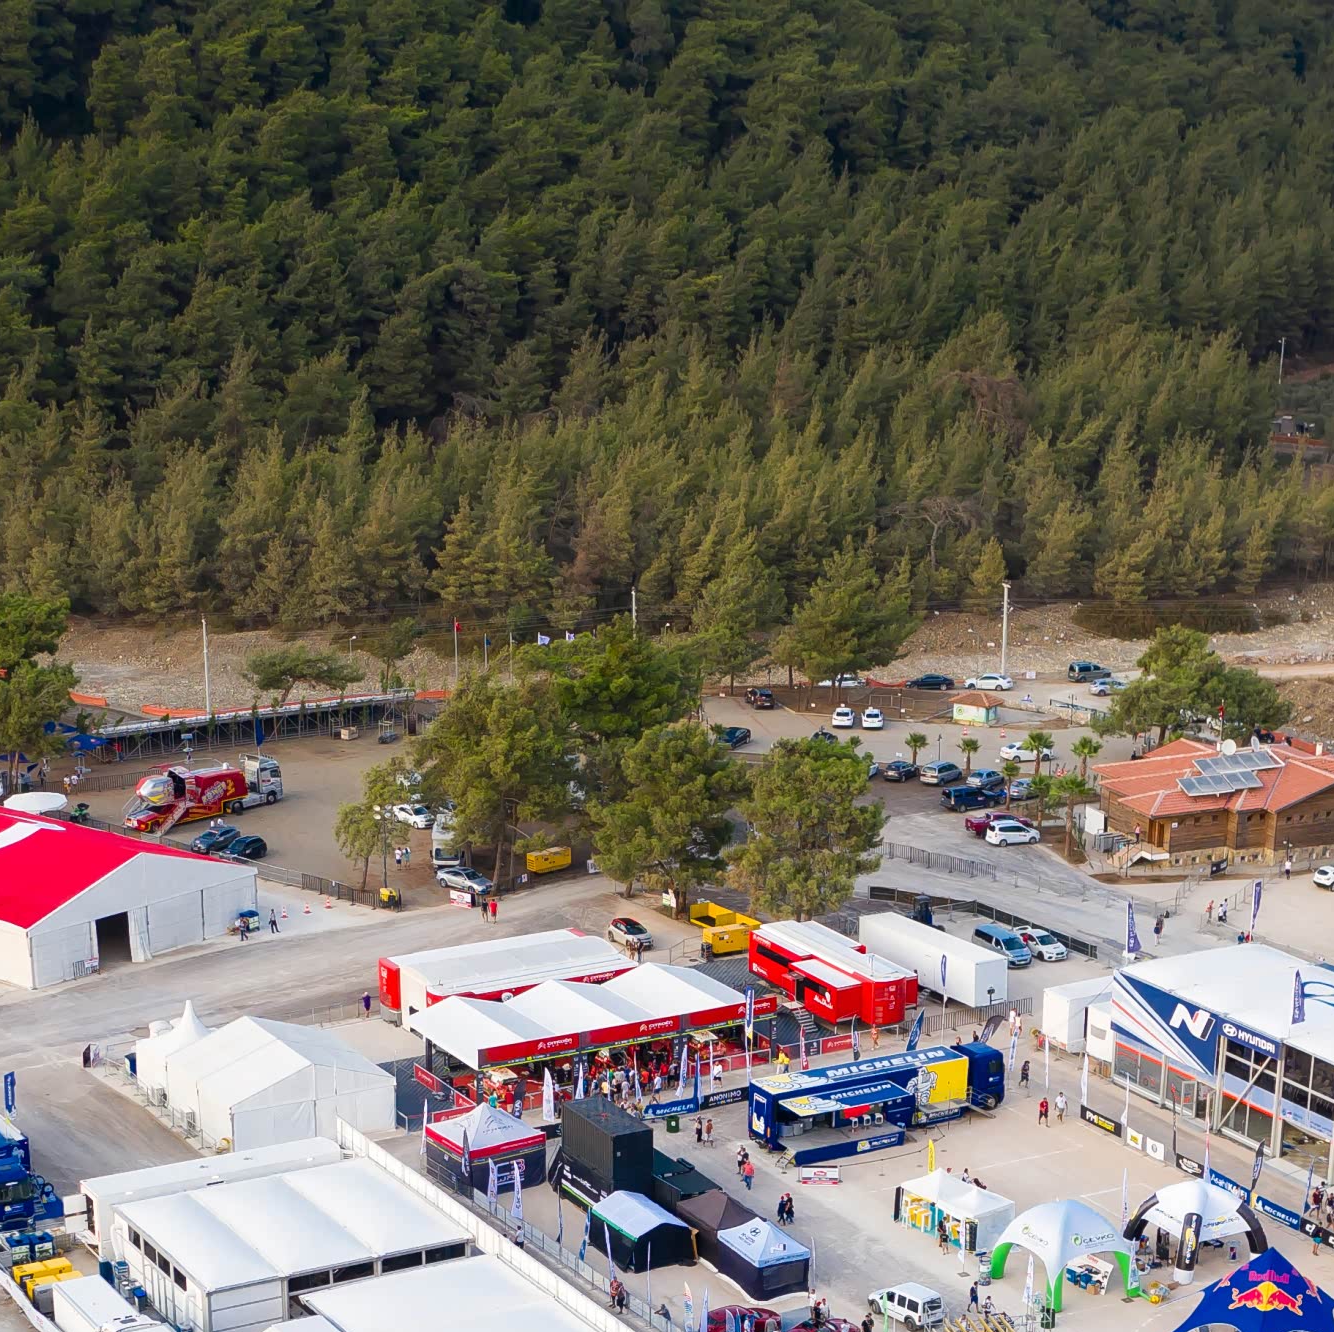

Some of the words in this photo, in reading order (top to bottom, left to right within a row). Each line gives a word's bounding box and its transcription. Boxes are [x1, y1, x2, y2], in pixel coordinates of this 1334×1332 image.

[1237, 1028, 1276, 1055] HYUNDAI
[825, 1049, 946, 1078] MICHELIN
[830, 1082, 892, 1100] MICHELIN
[1264, 1205, 1299, 1226] MICHELIN
